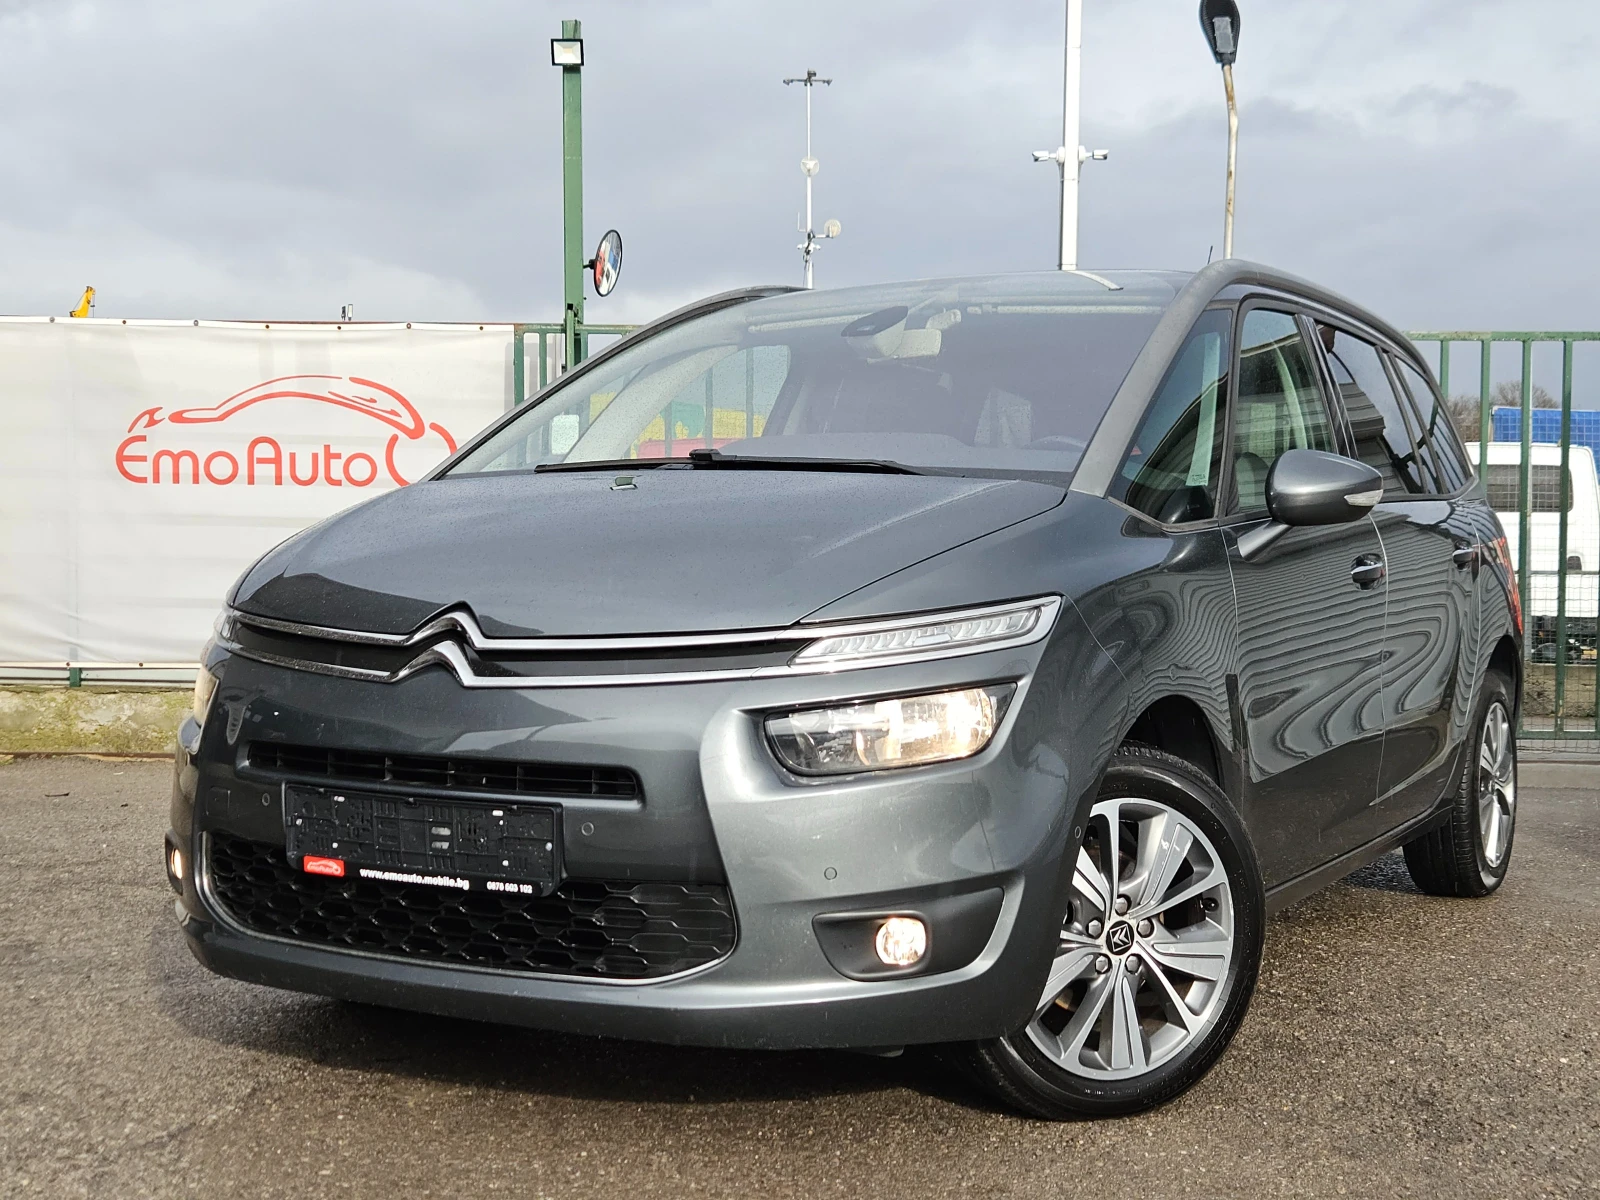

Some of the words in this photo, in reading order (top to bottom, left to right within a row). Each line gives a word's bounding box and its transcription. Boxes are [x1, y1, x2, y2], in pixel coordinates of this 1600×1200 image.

[115, 435, 378, 487] EmoAuto
[359, 868, 470, 891] www.emoauto.mobile.bg
[520, 884, 533, 894] 102
